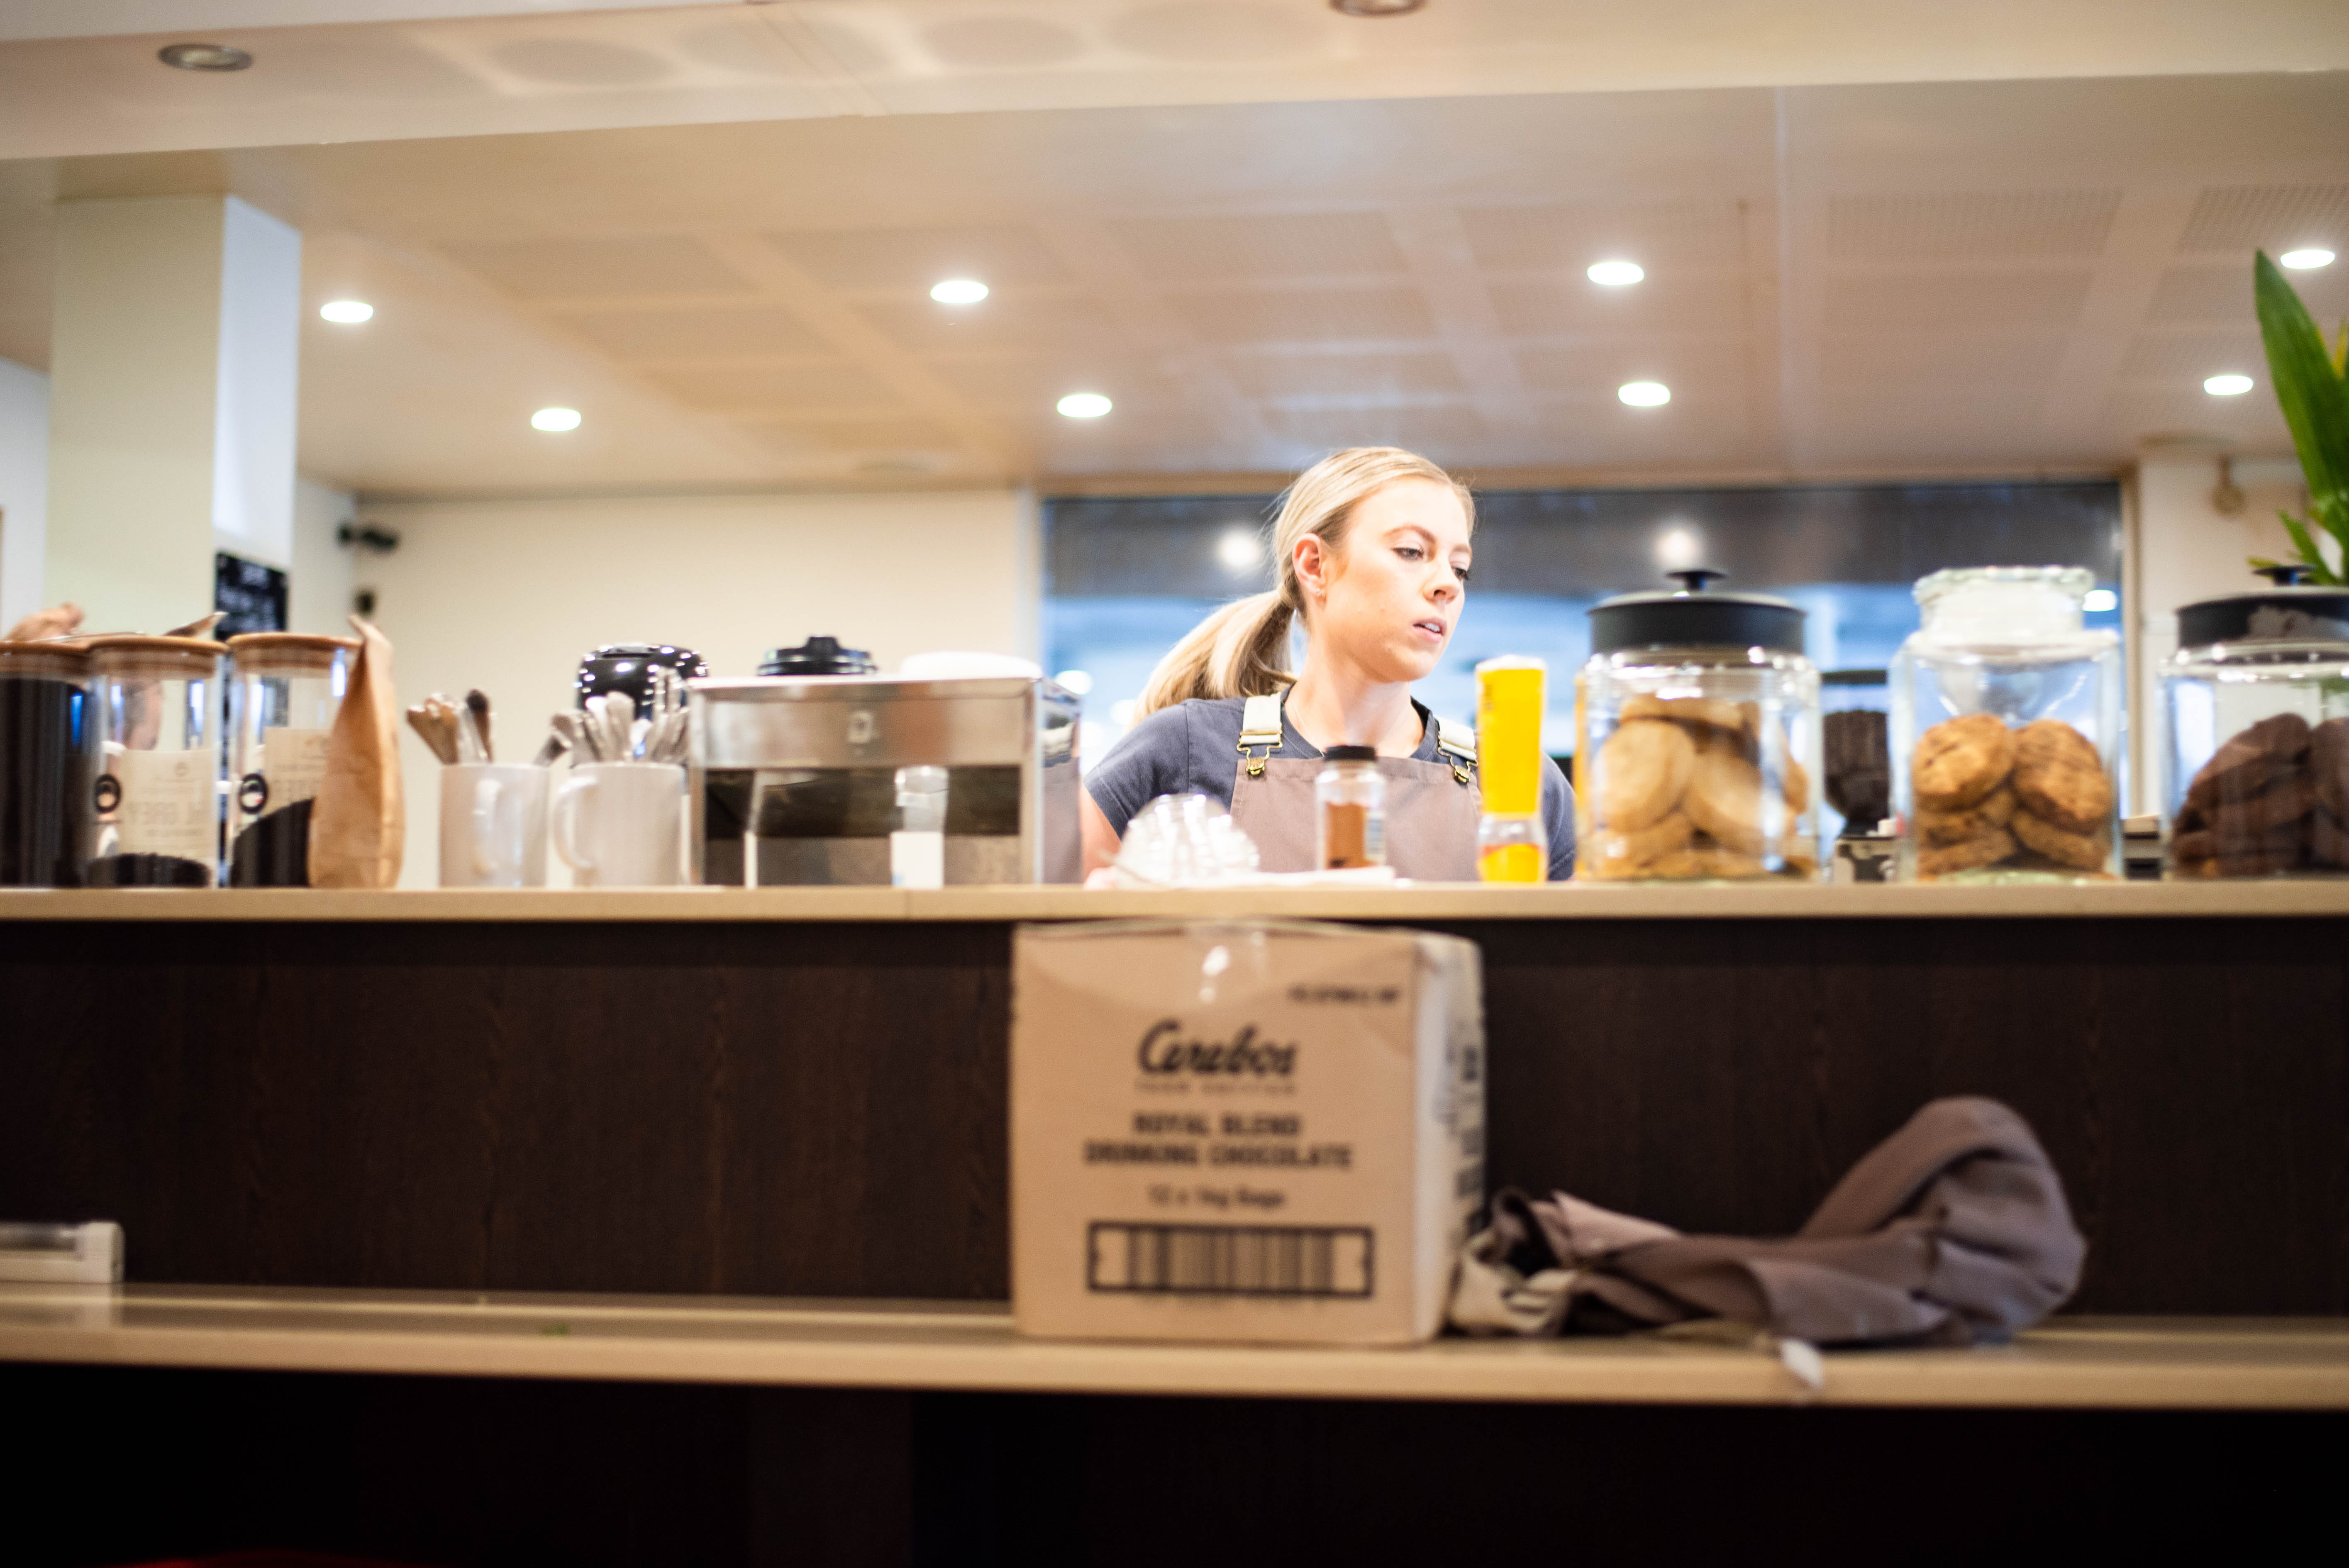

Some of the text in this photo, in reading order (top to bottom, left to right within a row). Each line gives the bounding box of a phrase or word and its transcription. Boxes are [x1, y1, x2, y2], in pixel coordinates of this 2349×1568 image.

[1137, 1017, 1297, 1075] Cerebos
[1133, 1112, 1301, 1136] ROYAL BLEND
[1085, 1140, 1352, 1170] DRINKING CHOCOLATE
